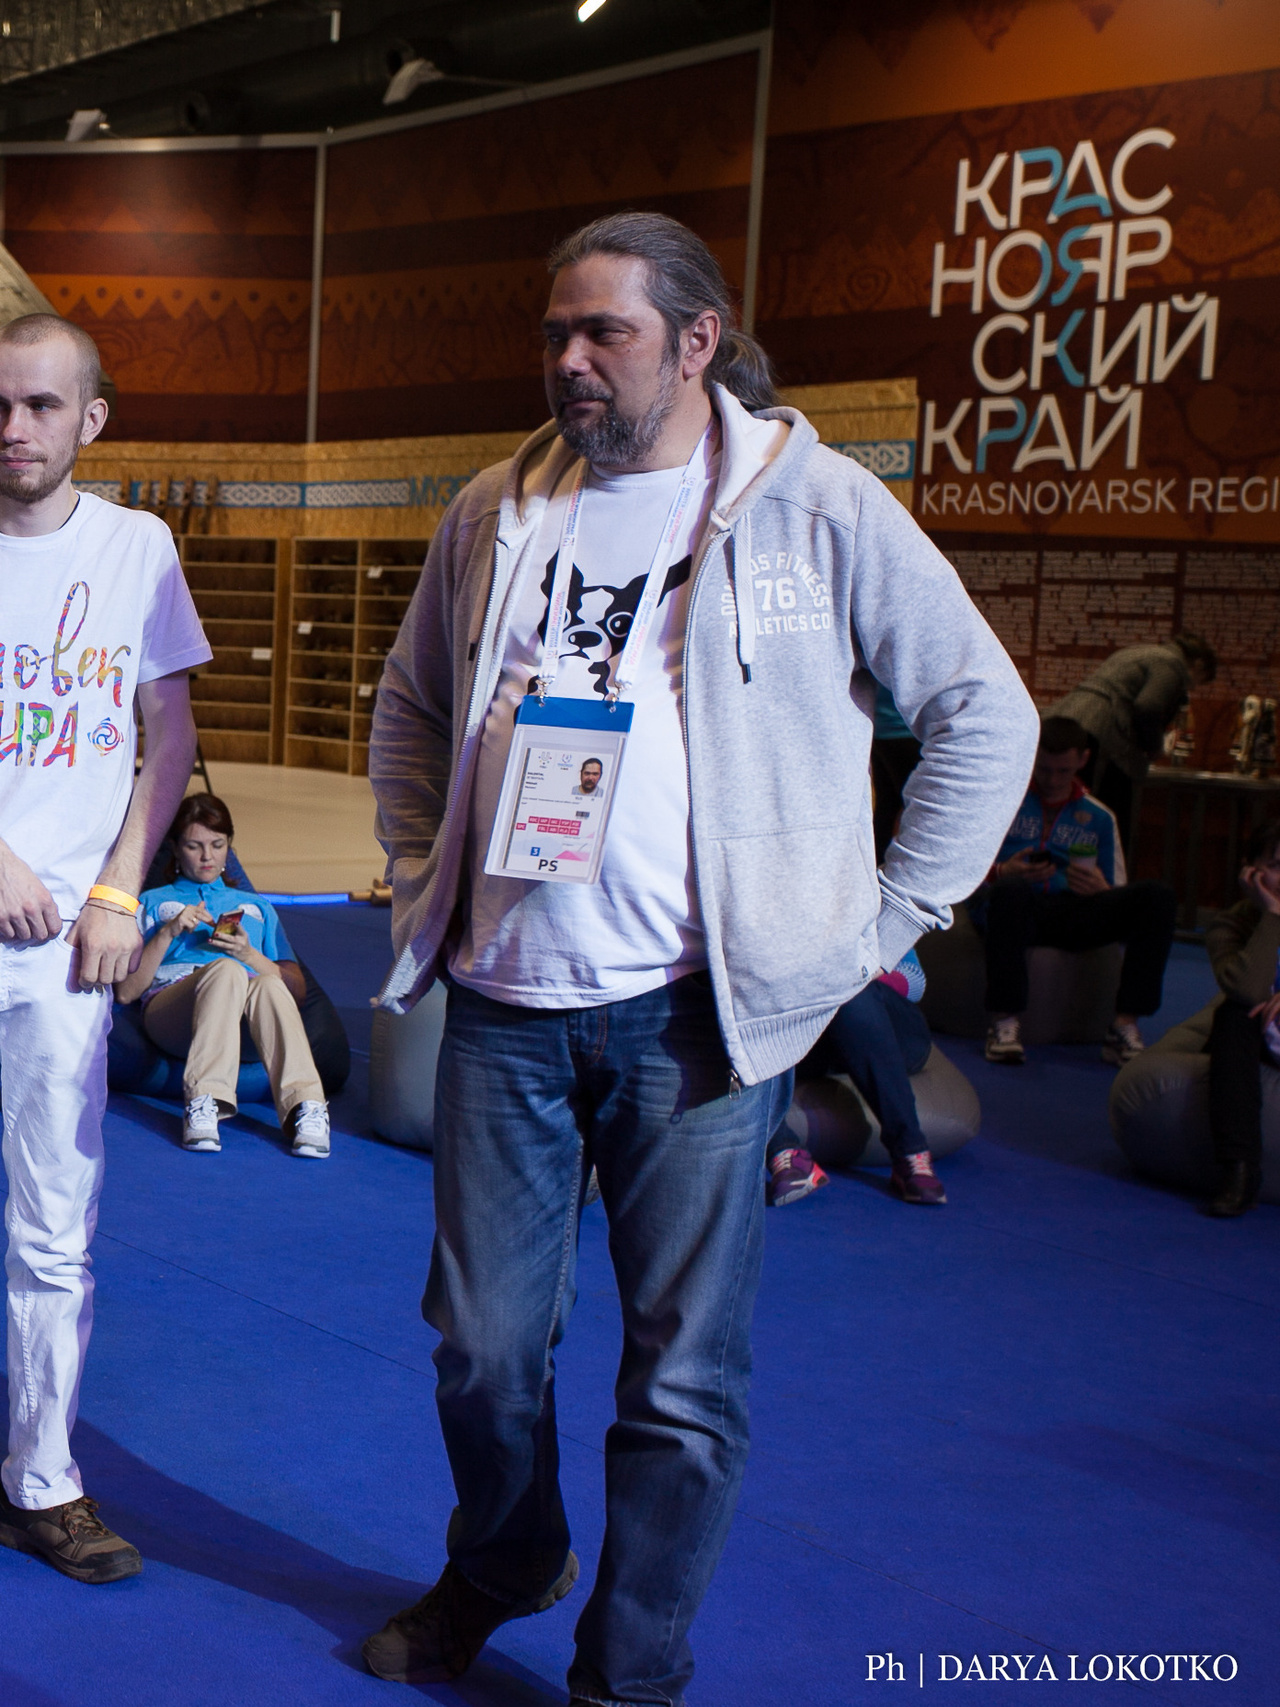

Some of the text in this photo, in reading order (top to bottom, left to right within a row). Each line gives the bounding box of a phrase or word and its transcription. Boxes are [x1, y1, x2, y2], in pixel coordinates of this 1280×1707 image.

[955, 127, 1177, 236] КРАС
[931, 216, 1173, 318] НОЯР
[972, 291, 1220, 394] СКИЙ
[921, 384, 1144, 476] КРАЙ
[921, 477, 1178, 516] KRASNOYARSK
[754, 577, 797, 612] 76
[775, 551, 831, 609] FITNESS
[810, 612, 831, 632] CO
[538, 859, 558, 872] PS
